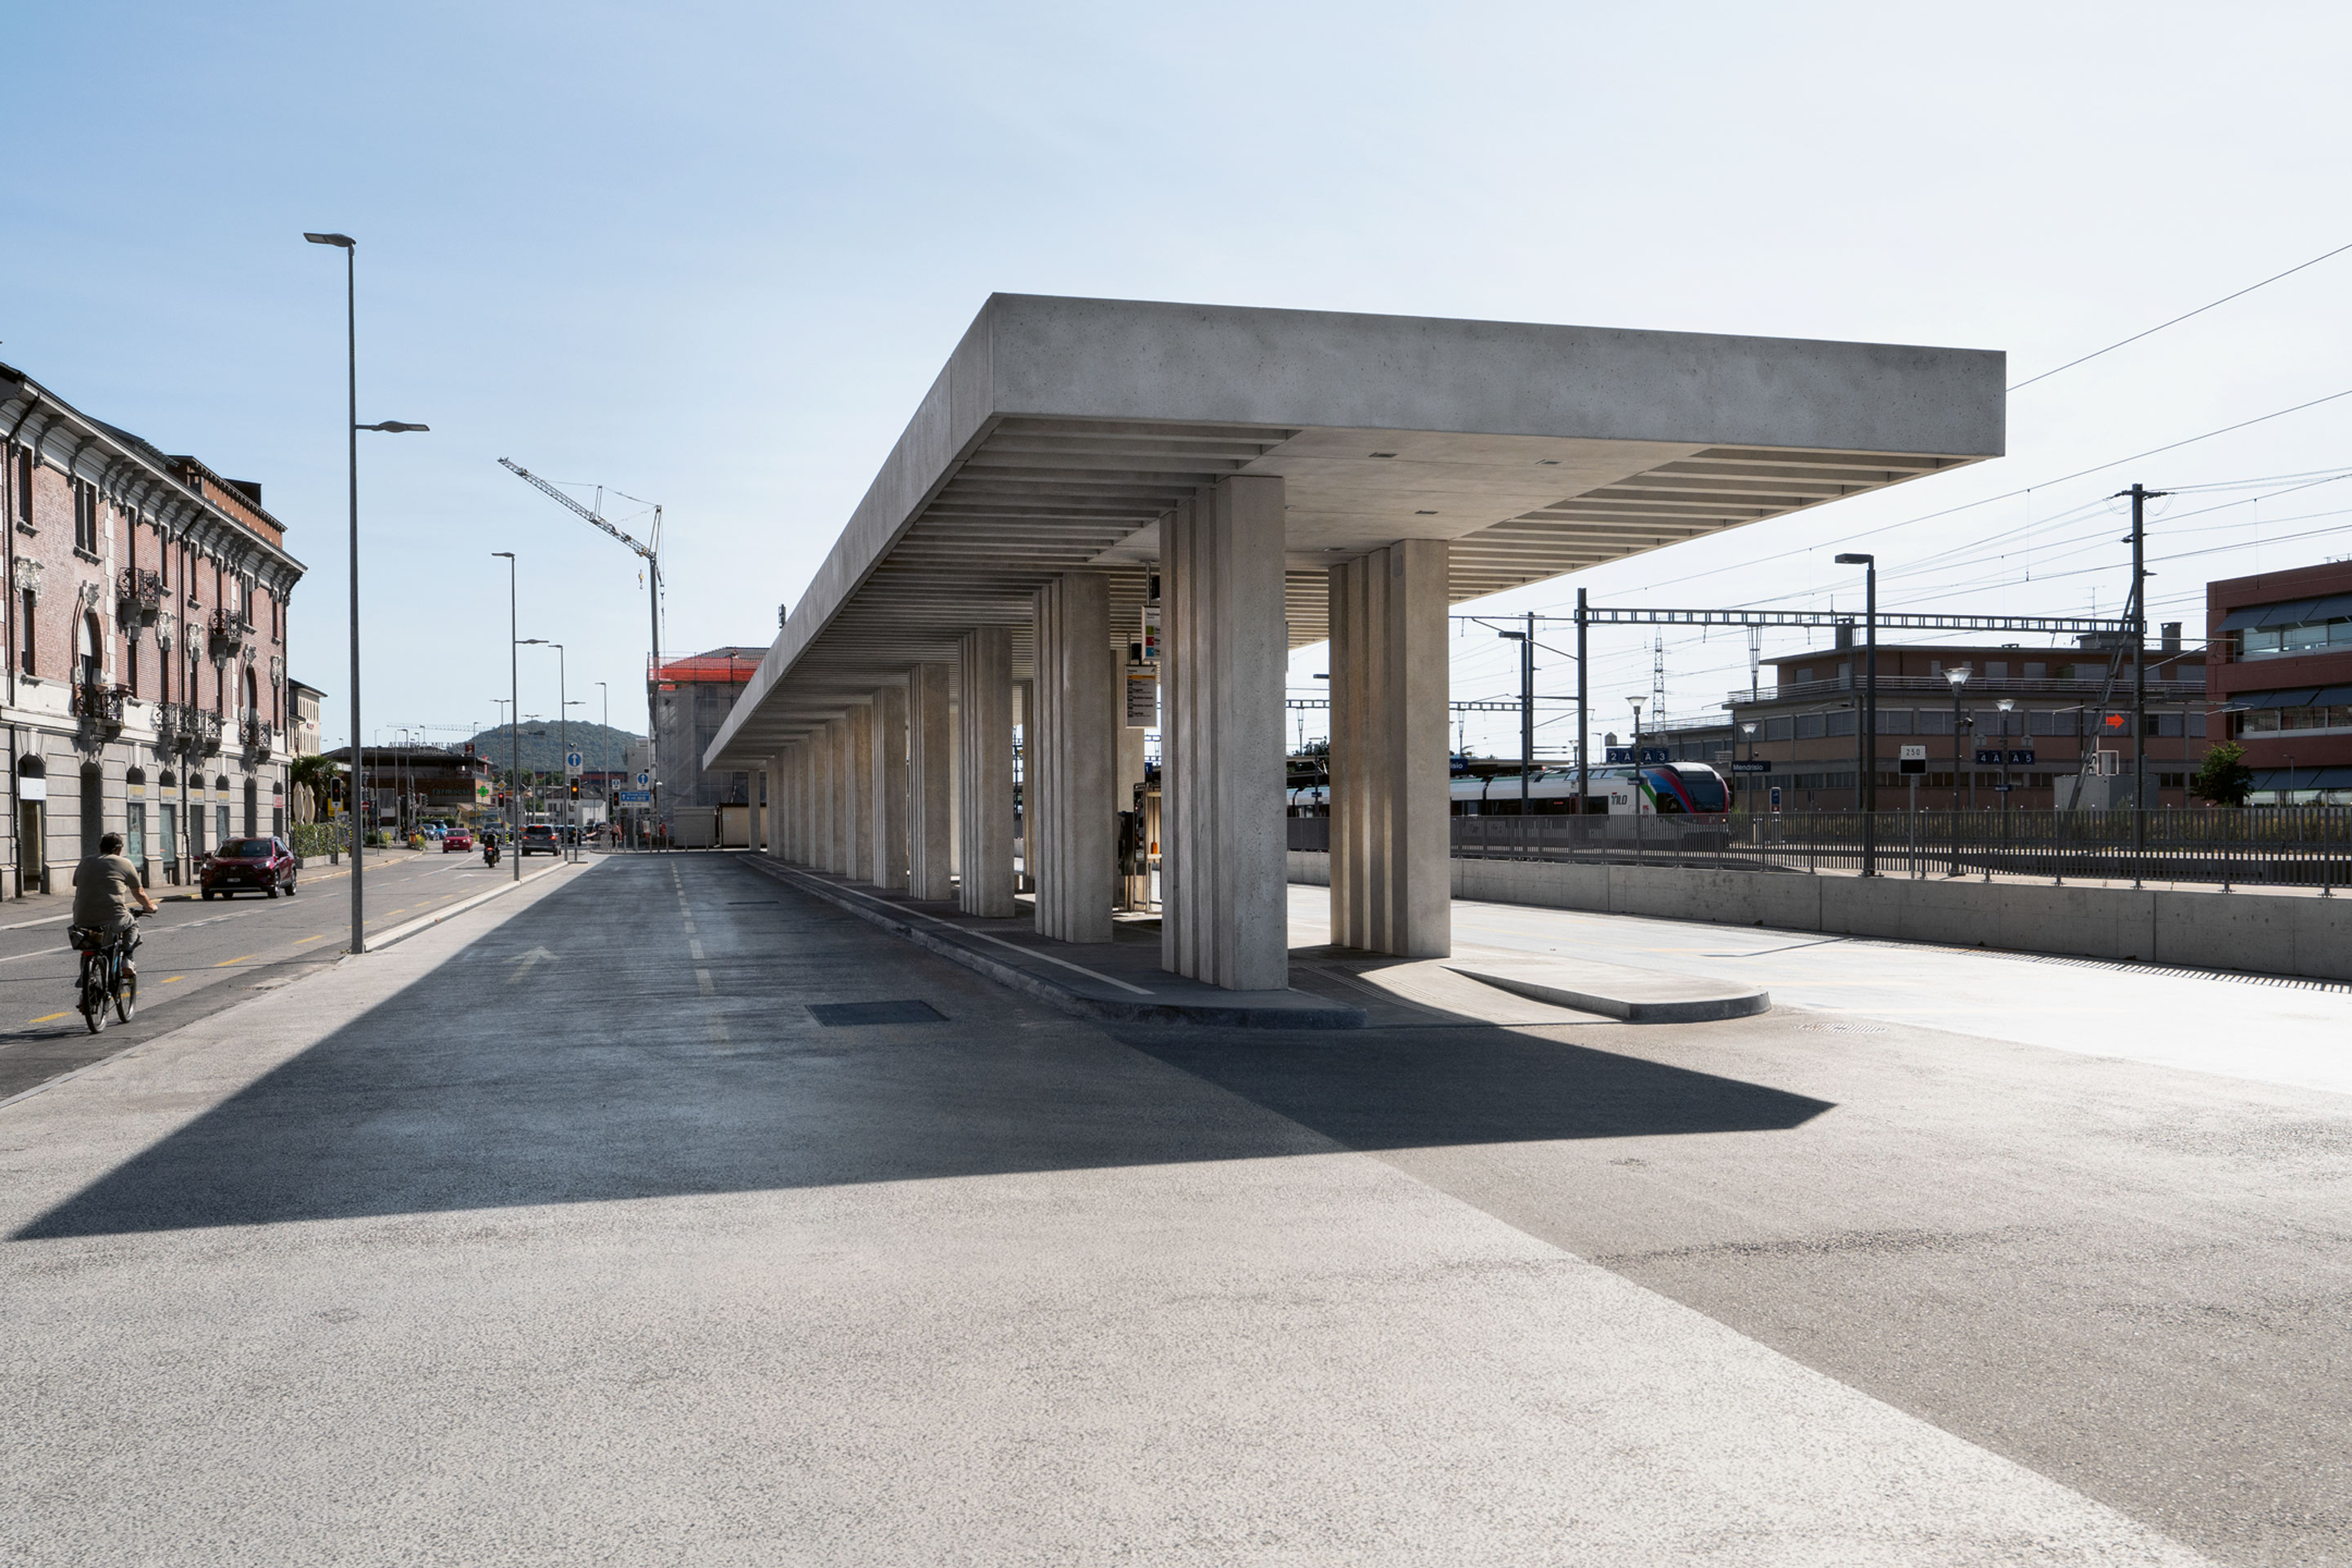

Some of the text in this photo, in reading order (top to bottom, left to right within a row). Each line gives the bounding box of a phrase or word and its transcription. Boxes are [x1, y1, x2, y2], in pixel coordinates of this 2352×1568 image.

[1610, 753, 1631, 761] 2 A
[1645, 753, 1665, 761] A 3
[1980, 755, 2000, 763] 4 A
[2012, 755, 2032, 763] A 5
